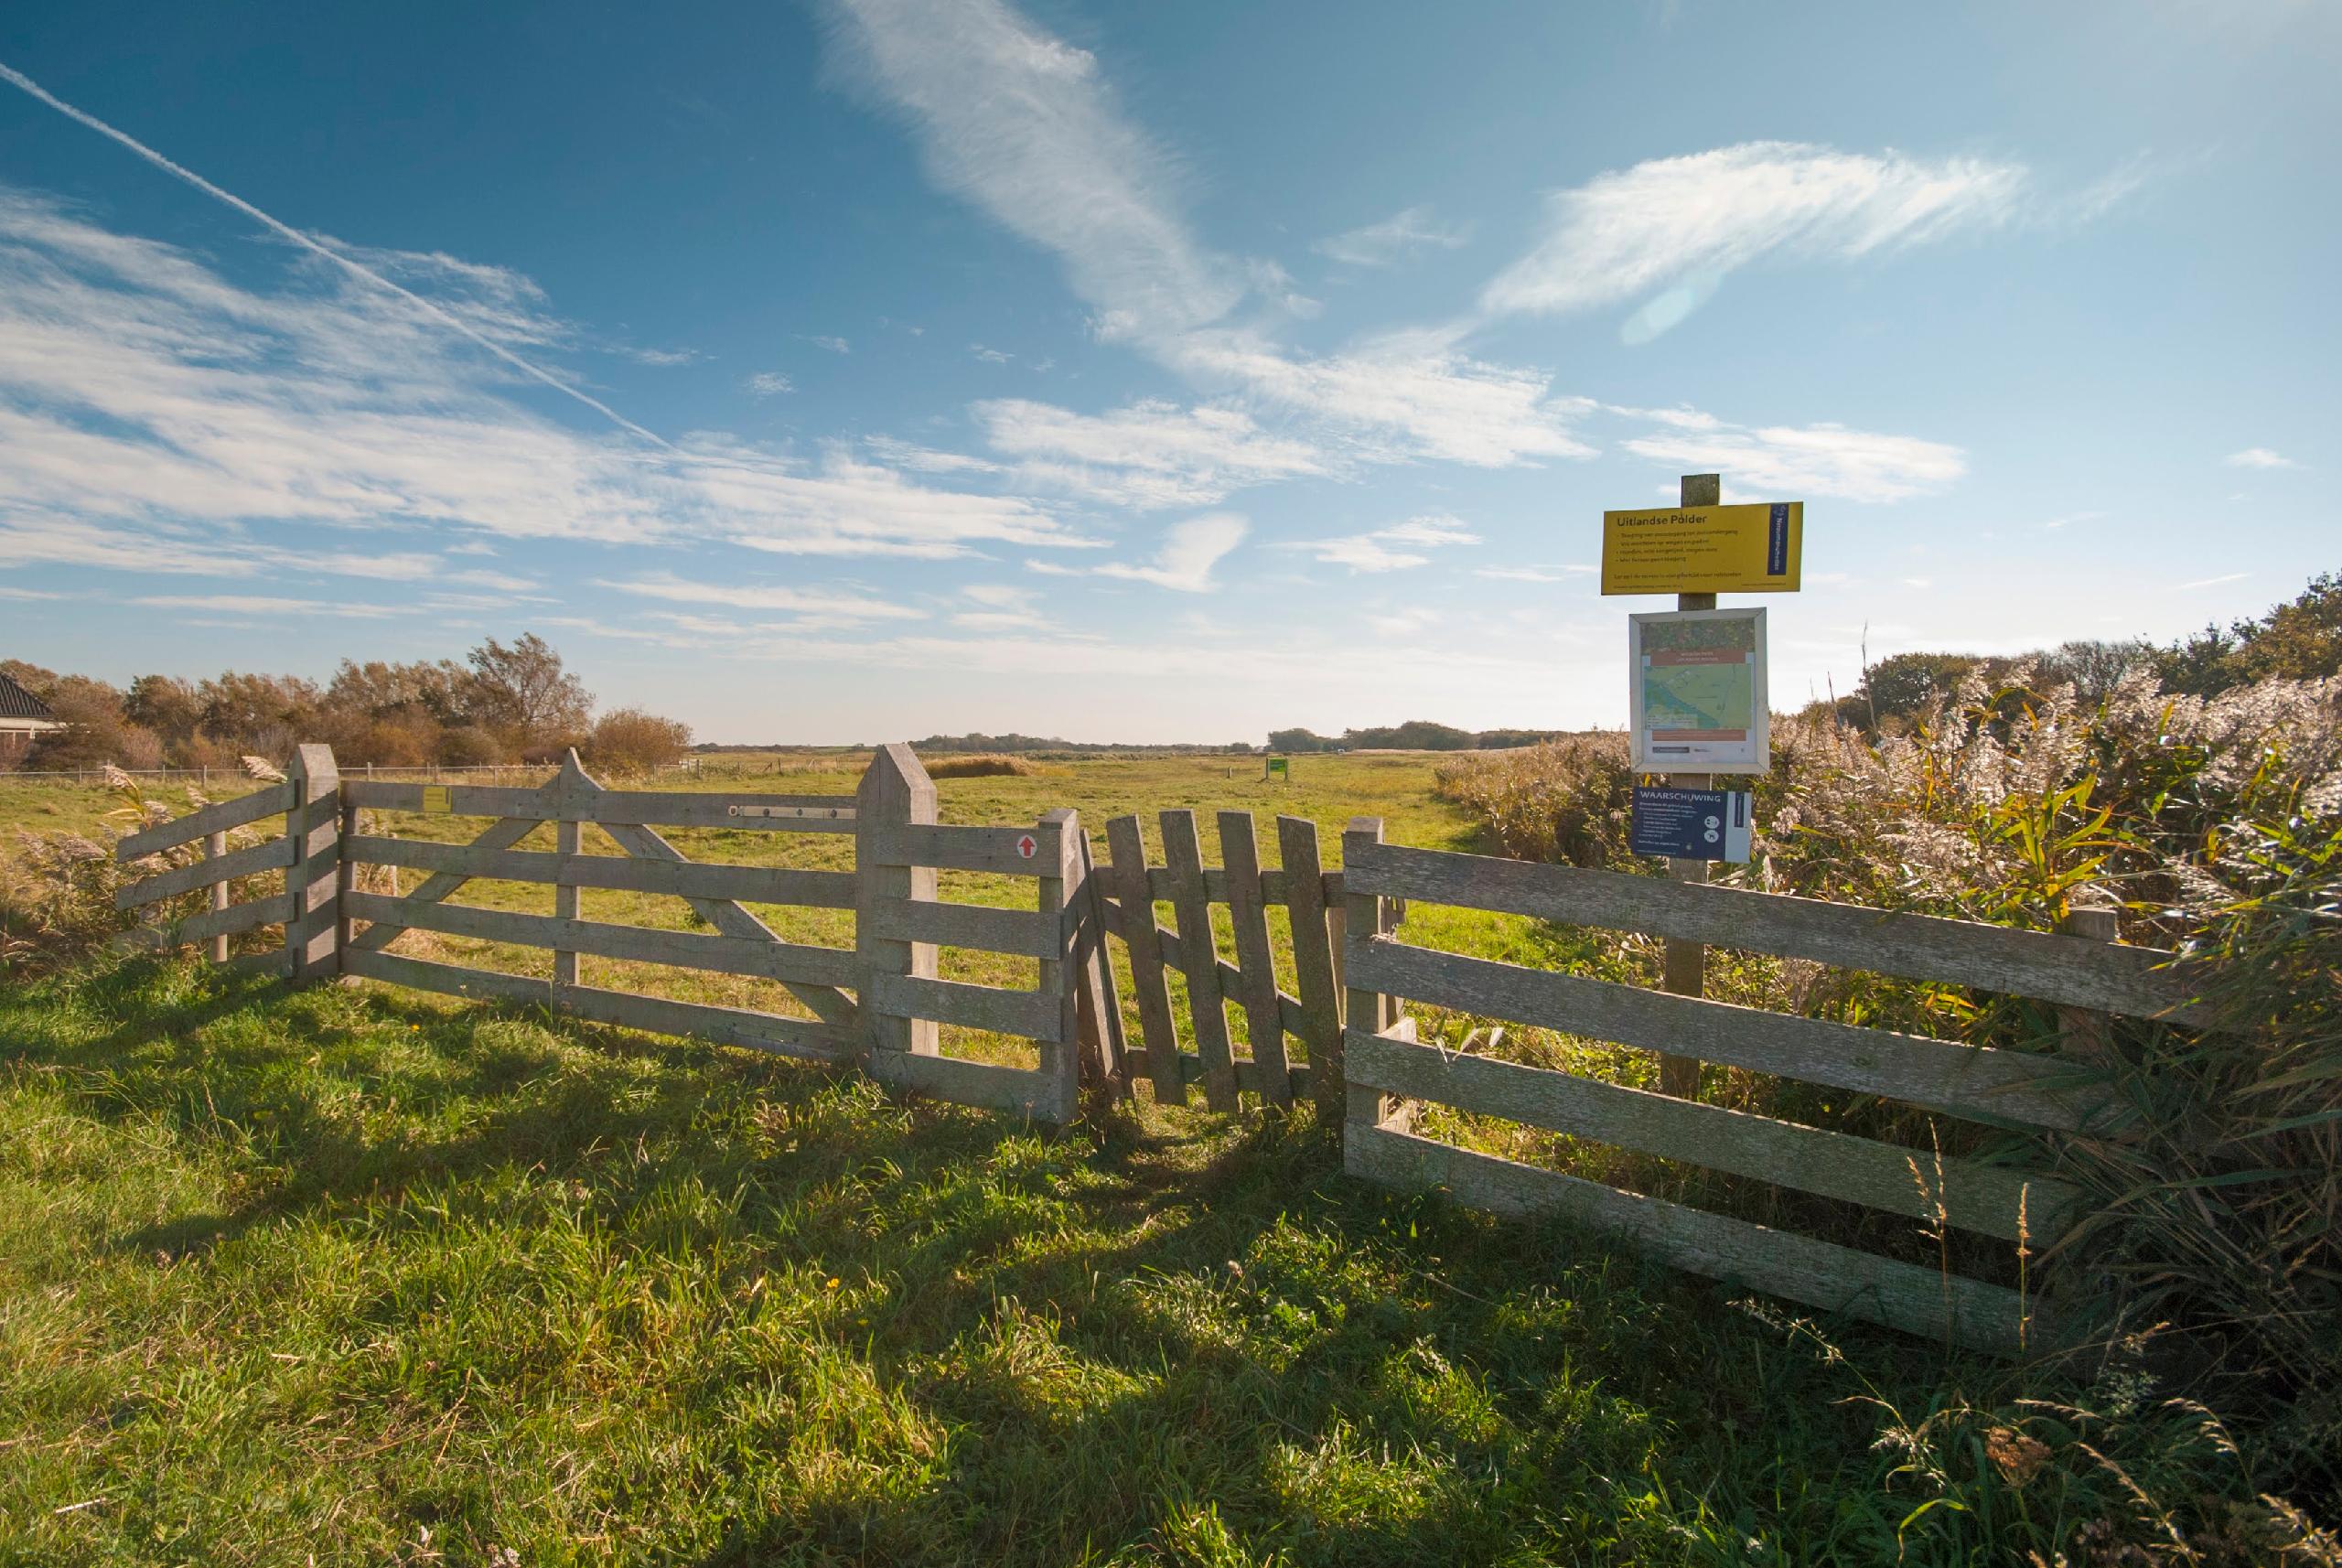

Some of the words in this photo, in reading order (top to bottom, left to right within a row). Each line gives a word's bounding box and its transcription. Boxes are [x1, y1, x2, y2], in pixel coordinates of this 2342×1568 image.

[1617, 515, 1669, 527] Uitlandse
[1671, 513, 1707, 524] Polder
[1639, 790, 1721, 802] WAARSCHUWING
